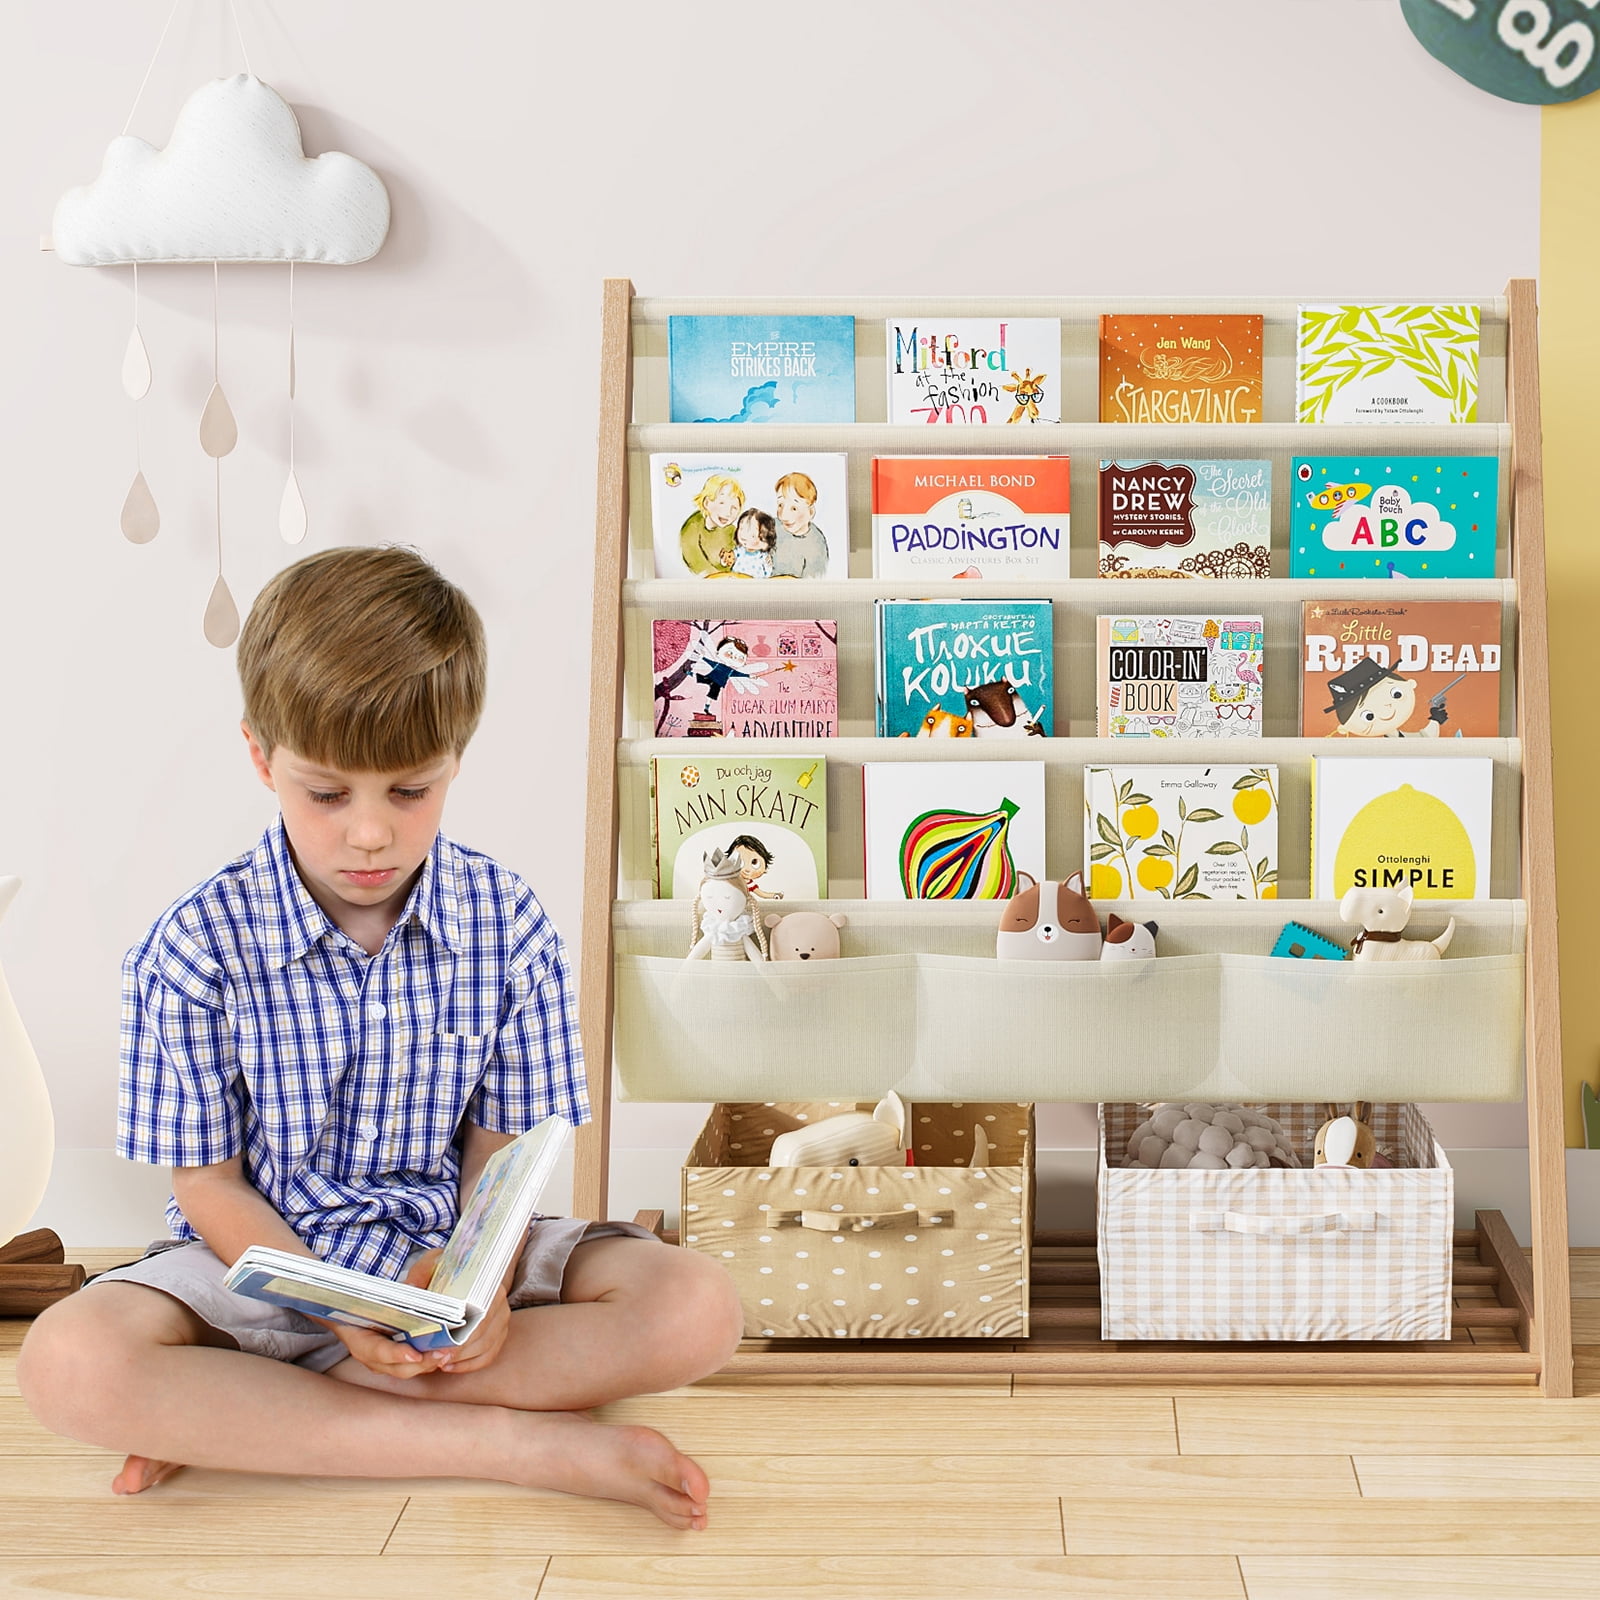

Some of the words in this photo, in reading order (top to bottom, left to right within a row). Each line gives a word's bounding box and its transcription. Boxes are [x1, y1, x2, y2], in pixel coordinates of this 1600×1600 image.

[731, 342, 815, 357] EMPIRE
[894, 324, 1008, 374] Mitford
[1156, 337, 1177, 349] Jen
[1181, 337, 1211, 351] Wang
[731, 357, 781, 376] STRIKES
[784, 357, 816, 376] BACK
[915, 370, 931, 388] at
[940, 368, 966, 384] the
[923, 378, 1000, 415] fashion
[1115, 382, 1256, 423] STARGAZING
[1376, 397, 1409, 405] COOKBOOK
[914, 475, 984, 487] MICHAEL
[990, 475, 1035, 487] BOND
[1200, 465, 1222, 480] The
[1112, 477, 1185, 491] NANCY
[1207, 469, 1264, 497] Secret
[1112, 493, 1185, 511] DREW
[1226, 491, 1268, 518] Old
[1379, 496, 1400, 507] Baby
[1379, 504, 1402, 514] Touch
[951, 620, 989, 631] МАРТА
[993, 619, 1036, 630] КЕТРО
[1340, 619, 1392, 643] Little
[1305, 635, 1390, 672] RED
[1397, 635, 1500, 672] DEAD
[778, 682, 791, 693] The
[731, 699, 767, 714] SUGAR
[769, 699, 796, 714] PLUM
[1124, 683, 1175, 712] BOOK
[717, 768, 731, 780] Du
[734, 765, 753, 776] och
[749, 768, 772, 783] jag
[1160, 780, 1182, 788] Emma
[1184, 780, 1217, 790] Galloway
[674, 789, 727, 835] MIN
[735, 785, 819, 829] SKATT
[1377, 854, 1431, 865] Ottolenghi
[1354, 868, 1454, 888] SIMPLE
